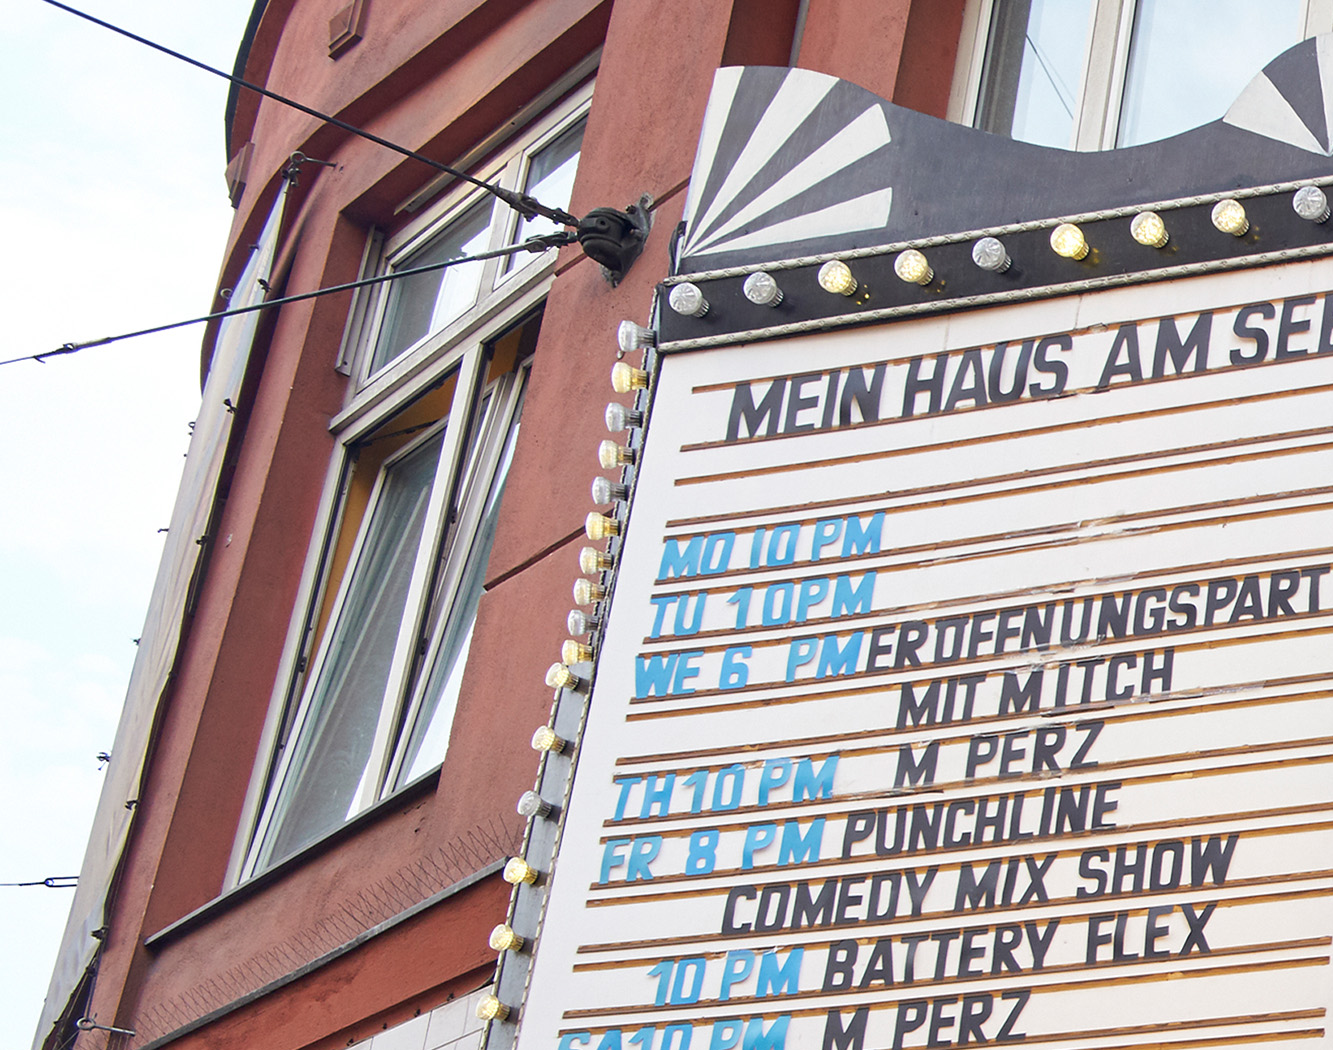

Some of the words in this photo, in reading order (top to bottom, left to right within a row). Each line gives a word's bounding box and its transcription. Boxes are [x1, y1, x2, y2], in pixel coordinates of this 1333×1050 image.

[725, 363, 887, 442] MEIN
[901, 334, 1073, 419] HAUS
[1100, 310, 1215, 387] AM
[657, 532, 736, 581] MO
[810, 511, 886, 562] PM
[650, 592, 708, 639] TU
[634, 651, 705, 700] WE
[718, 645, 753, 691] 6
[784, 630, 864, 683] PM
[895, 673, 987, 730] MIT
[997, 646, 1176, 717] MITCH
[757, 755, 841, 807] PM
[892, 741, 941, 790] M
[965, 720, 1106, 779] PERZ
[598, 835, 664, 885] FR
[684, 829, 720, 876] 8
[740, 817, 827, 870] PM
[841, 782, 1124, 861] PUNCHLINE
[720, 867, 941, 936] COMEDY
[951, 854, 1058, 913] MIX
[1076, 834, 1240, 901] SHOW
[646, 957, 707, 1007] 10
[718, 947, 805, 1002] PM
[820, 919, 1062, 994] BATTERY
[1084, 903, 1219, 966] FLEX
